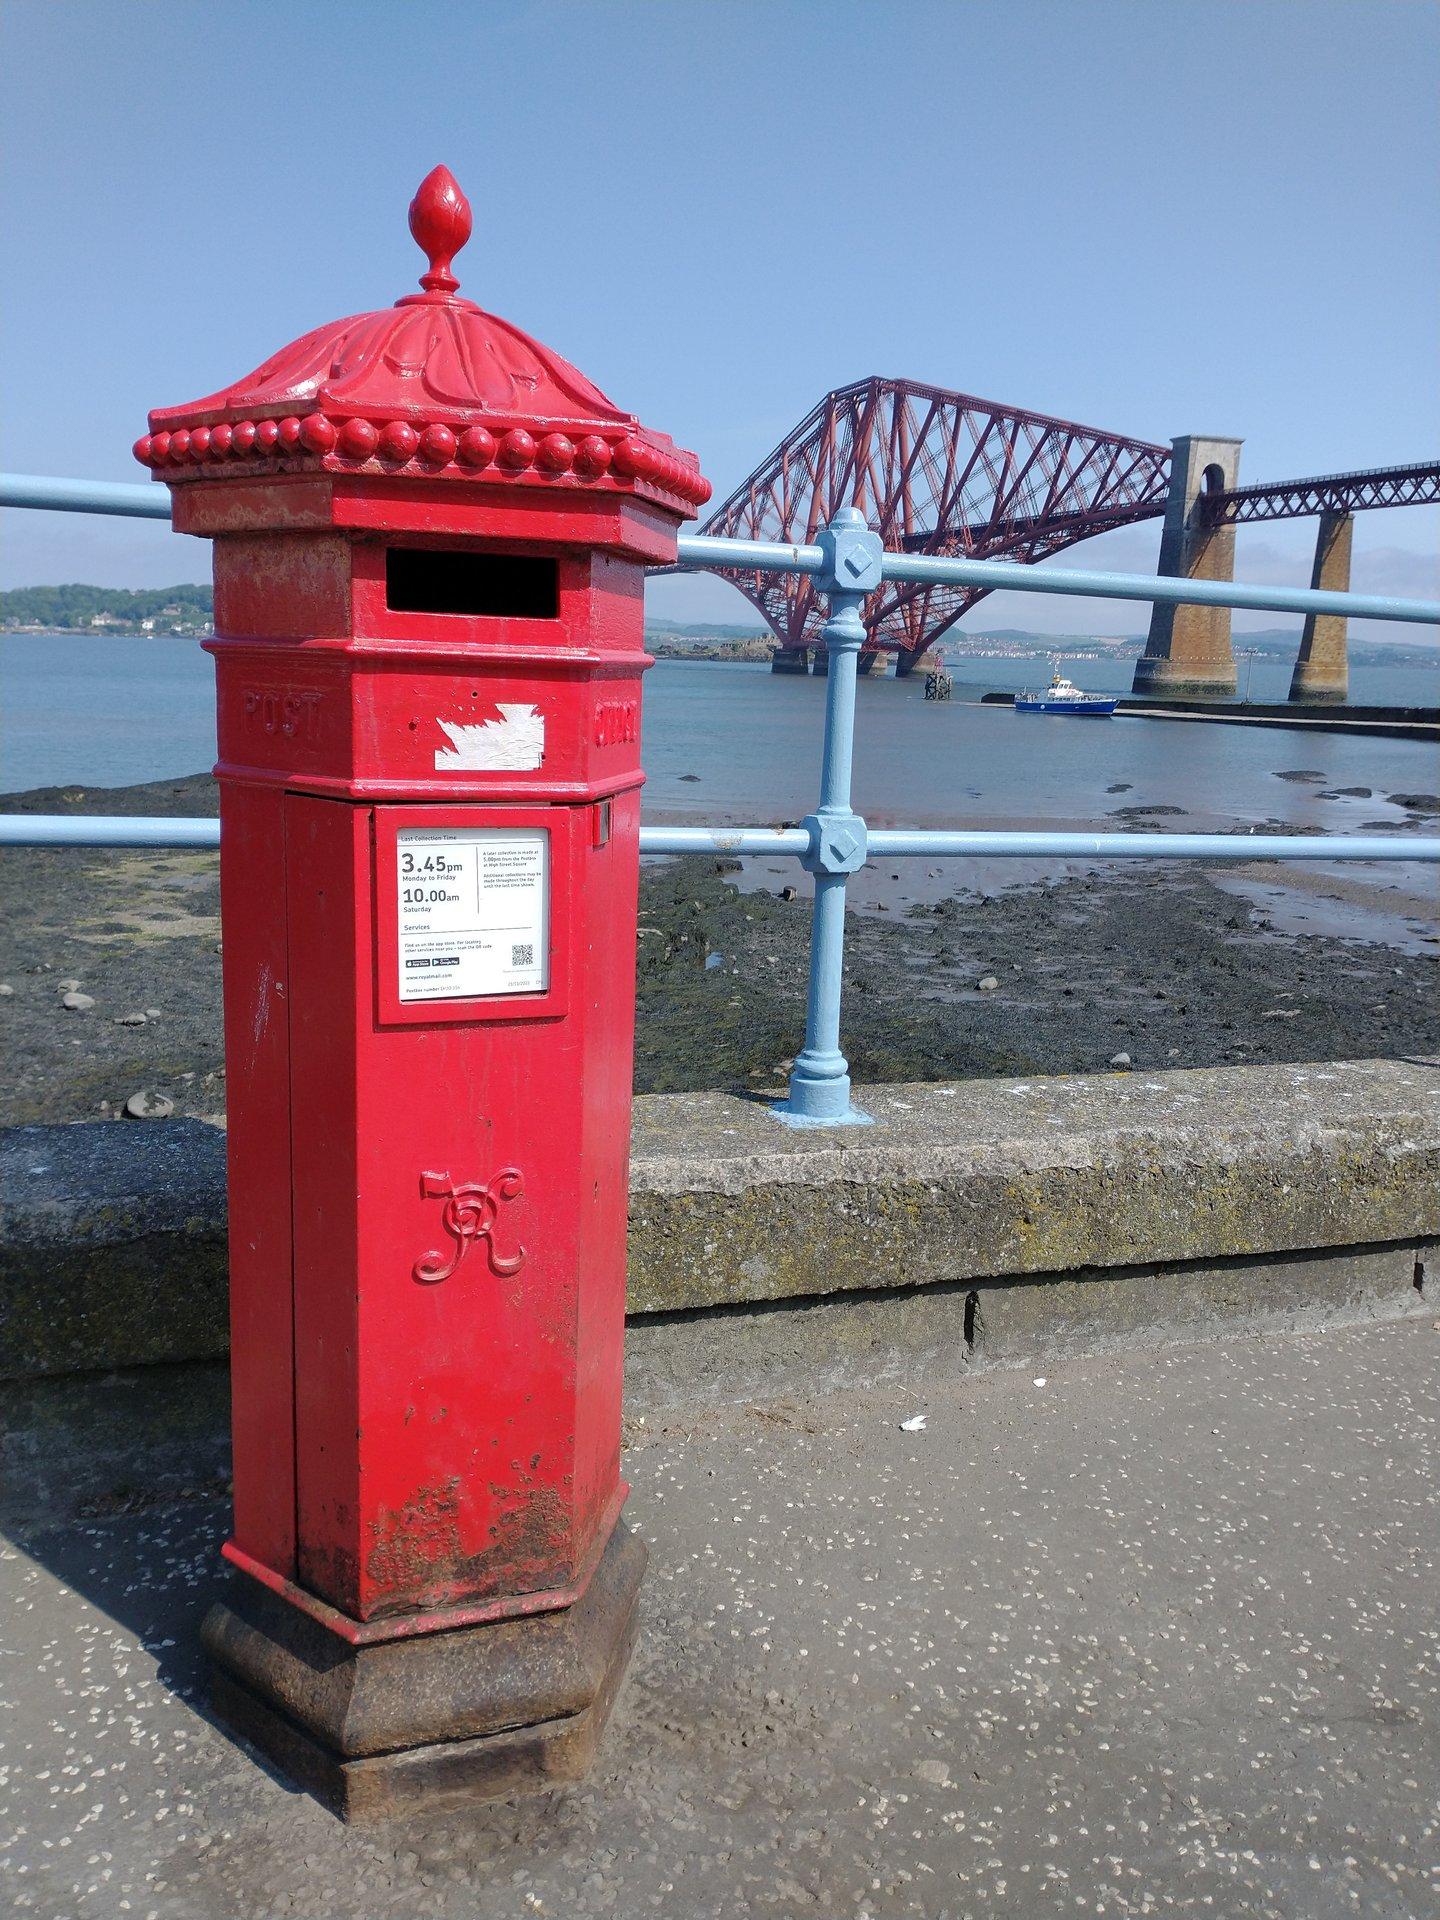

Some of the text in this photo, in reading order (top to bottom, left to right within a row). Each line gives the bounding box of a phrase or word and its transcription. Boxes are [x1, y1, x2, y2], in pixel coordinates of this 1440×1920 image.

[401, 853, 463, 873] 3.45pm
[402, 874, 426, 882] Monday
[403, 889, 460, 902] 10.00am
